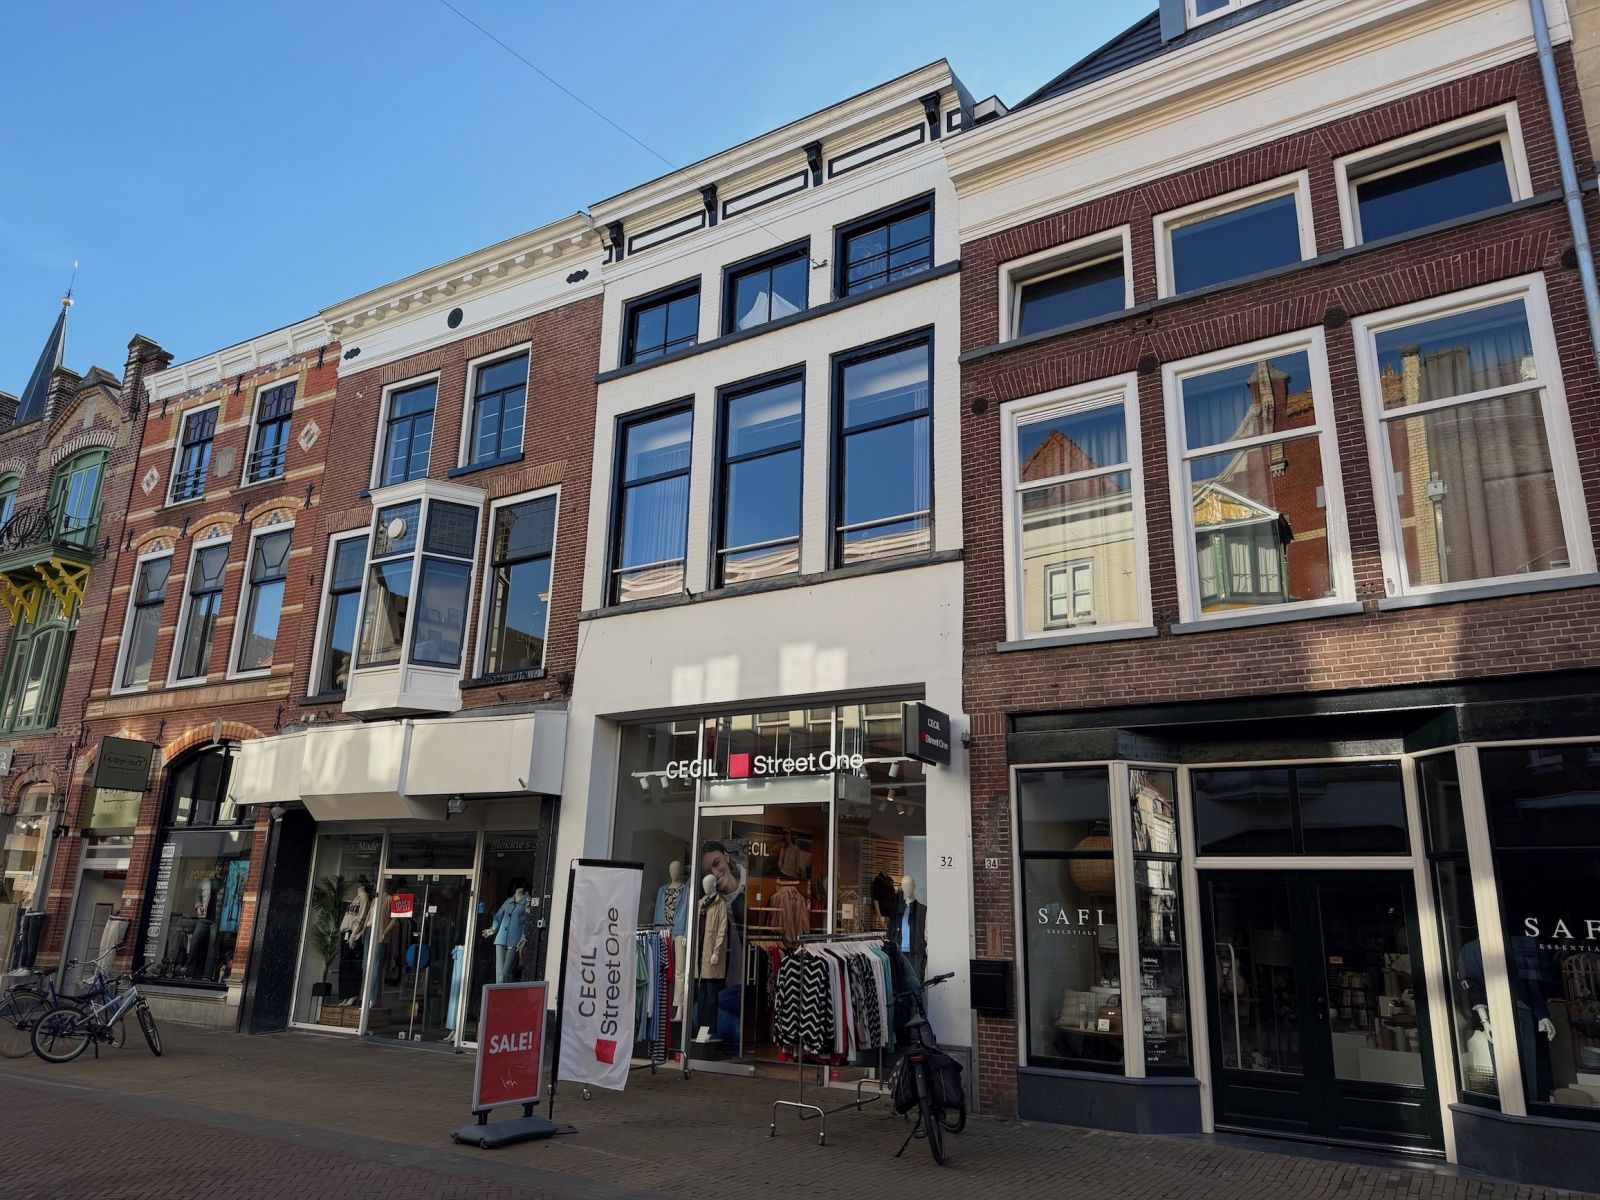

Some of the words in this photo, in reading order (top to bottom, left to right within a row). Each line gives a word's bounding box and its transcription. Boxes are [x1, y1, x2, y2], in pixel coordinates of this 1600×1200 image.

[927, 718, 940, 731] CECIL
[925, 734, 939, 747] Street
[939, 739, 949, 750] One
[666, 759, 718, 779] CECIL
[754, 753, 816, 775] Street
[818, 751, 864, 771] One
[940, 856, 953, 867] 32
[986, 859, 997, 868] 34
[1038, 907, 1105, 926] SAFI
[605, 907, 620, 956] One
[578, 947, 598, 1017] CECIL
[601, 960, 621, 1036] Street
[489, 1031, 533, 1055] SALE!
